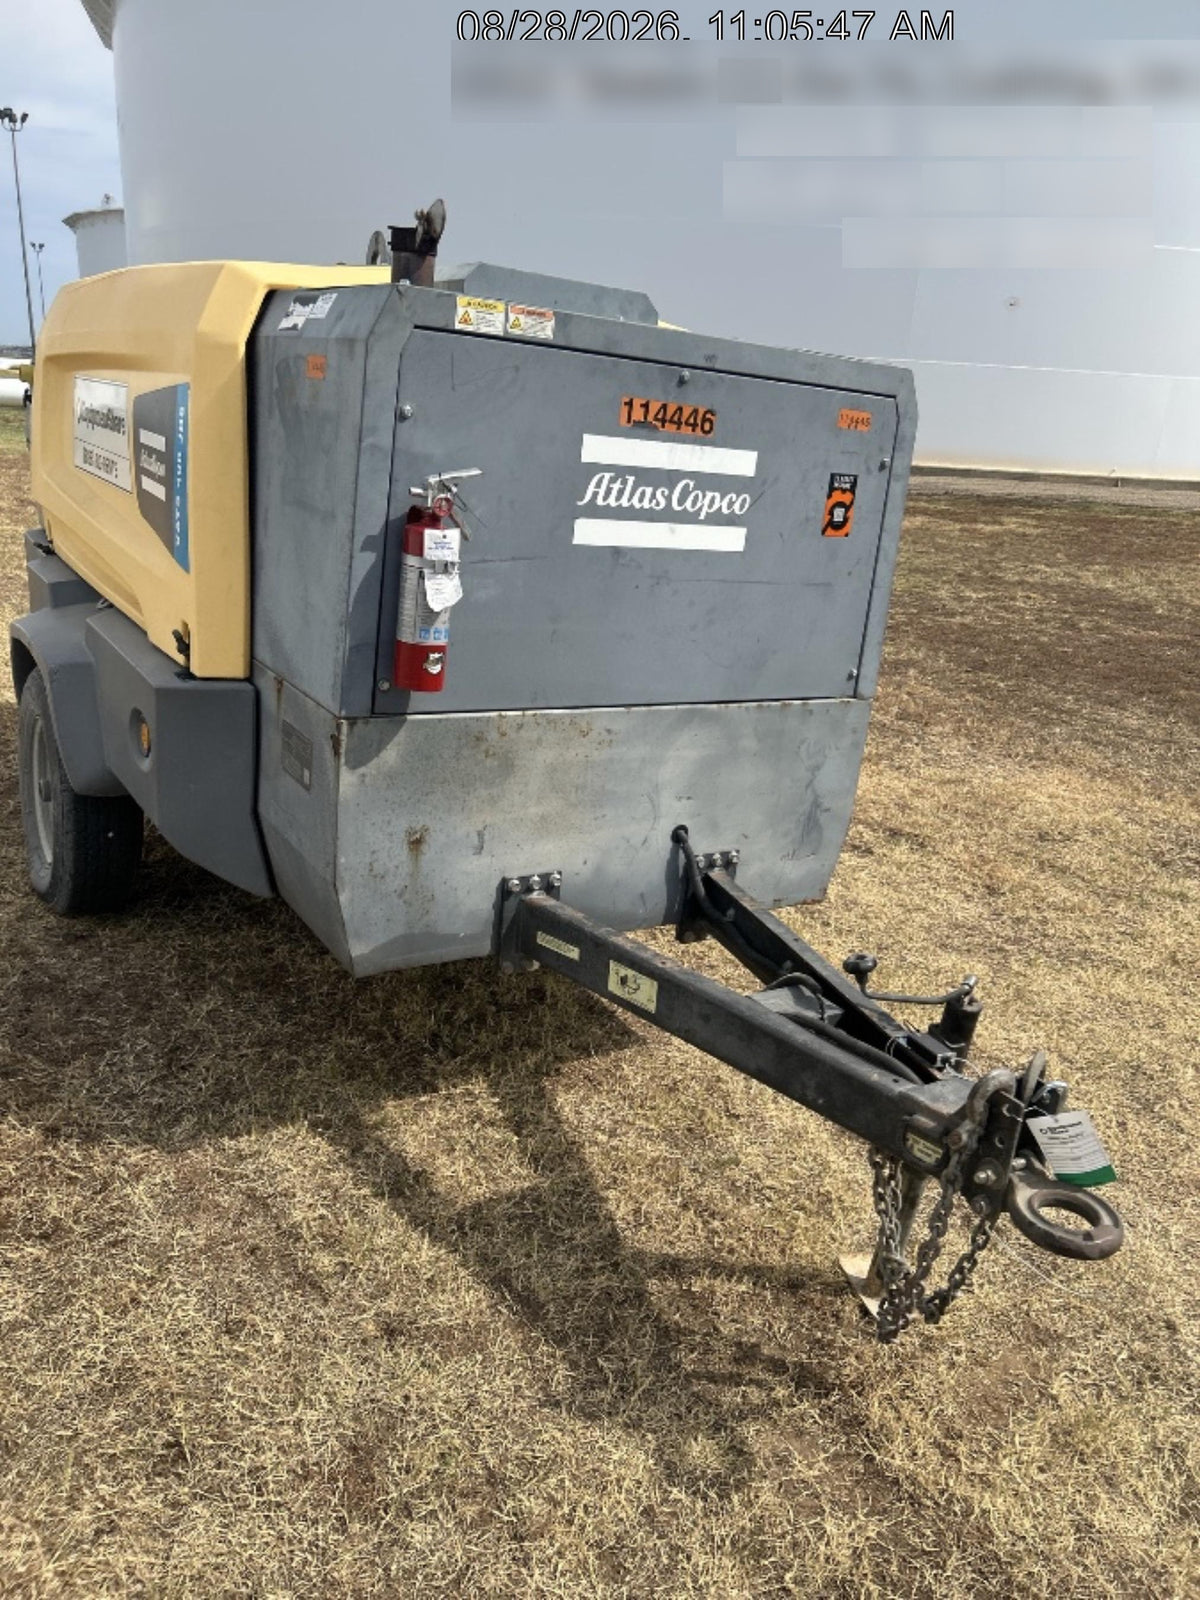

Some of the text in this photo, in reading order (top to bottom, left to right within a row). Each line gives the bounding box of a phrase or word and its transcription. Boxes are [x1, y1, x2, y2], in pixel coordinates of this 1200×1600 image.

[624, 398, 717, 435] 114446
[577, 472, 750, 519] Atlas Copco
